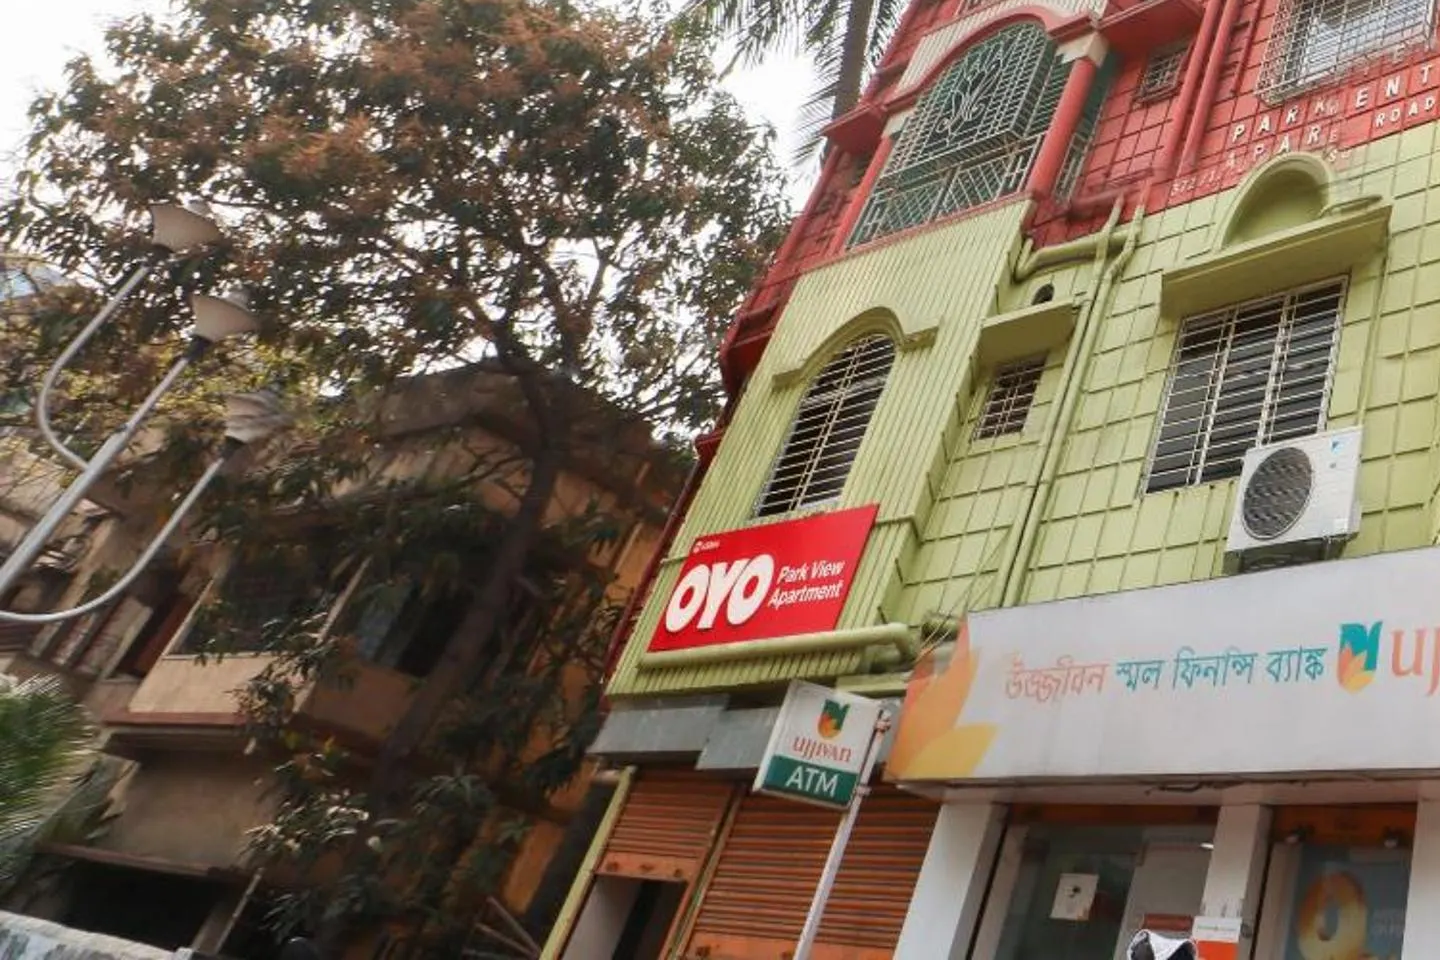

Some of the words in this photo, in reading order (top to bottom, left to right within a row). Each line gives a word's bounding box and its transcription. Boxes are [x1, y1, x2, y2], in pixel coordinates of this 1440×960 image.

[776, 564, 809, 586] Park
[811, 559, 845, 580] View
[665, 553, 775, 633] OYO
[768, 581, 844, 611] Apartment
[784, 765, 840, 798] ATM
